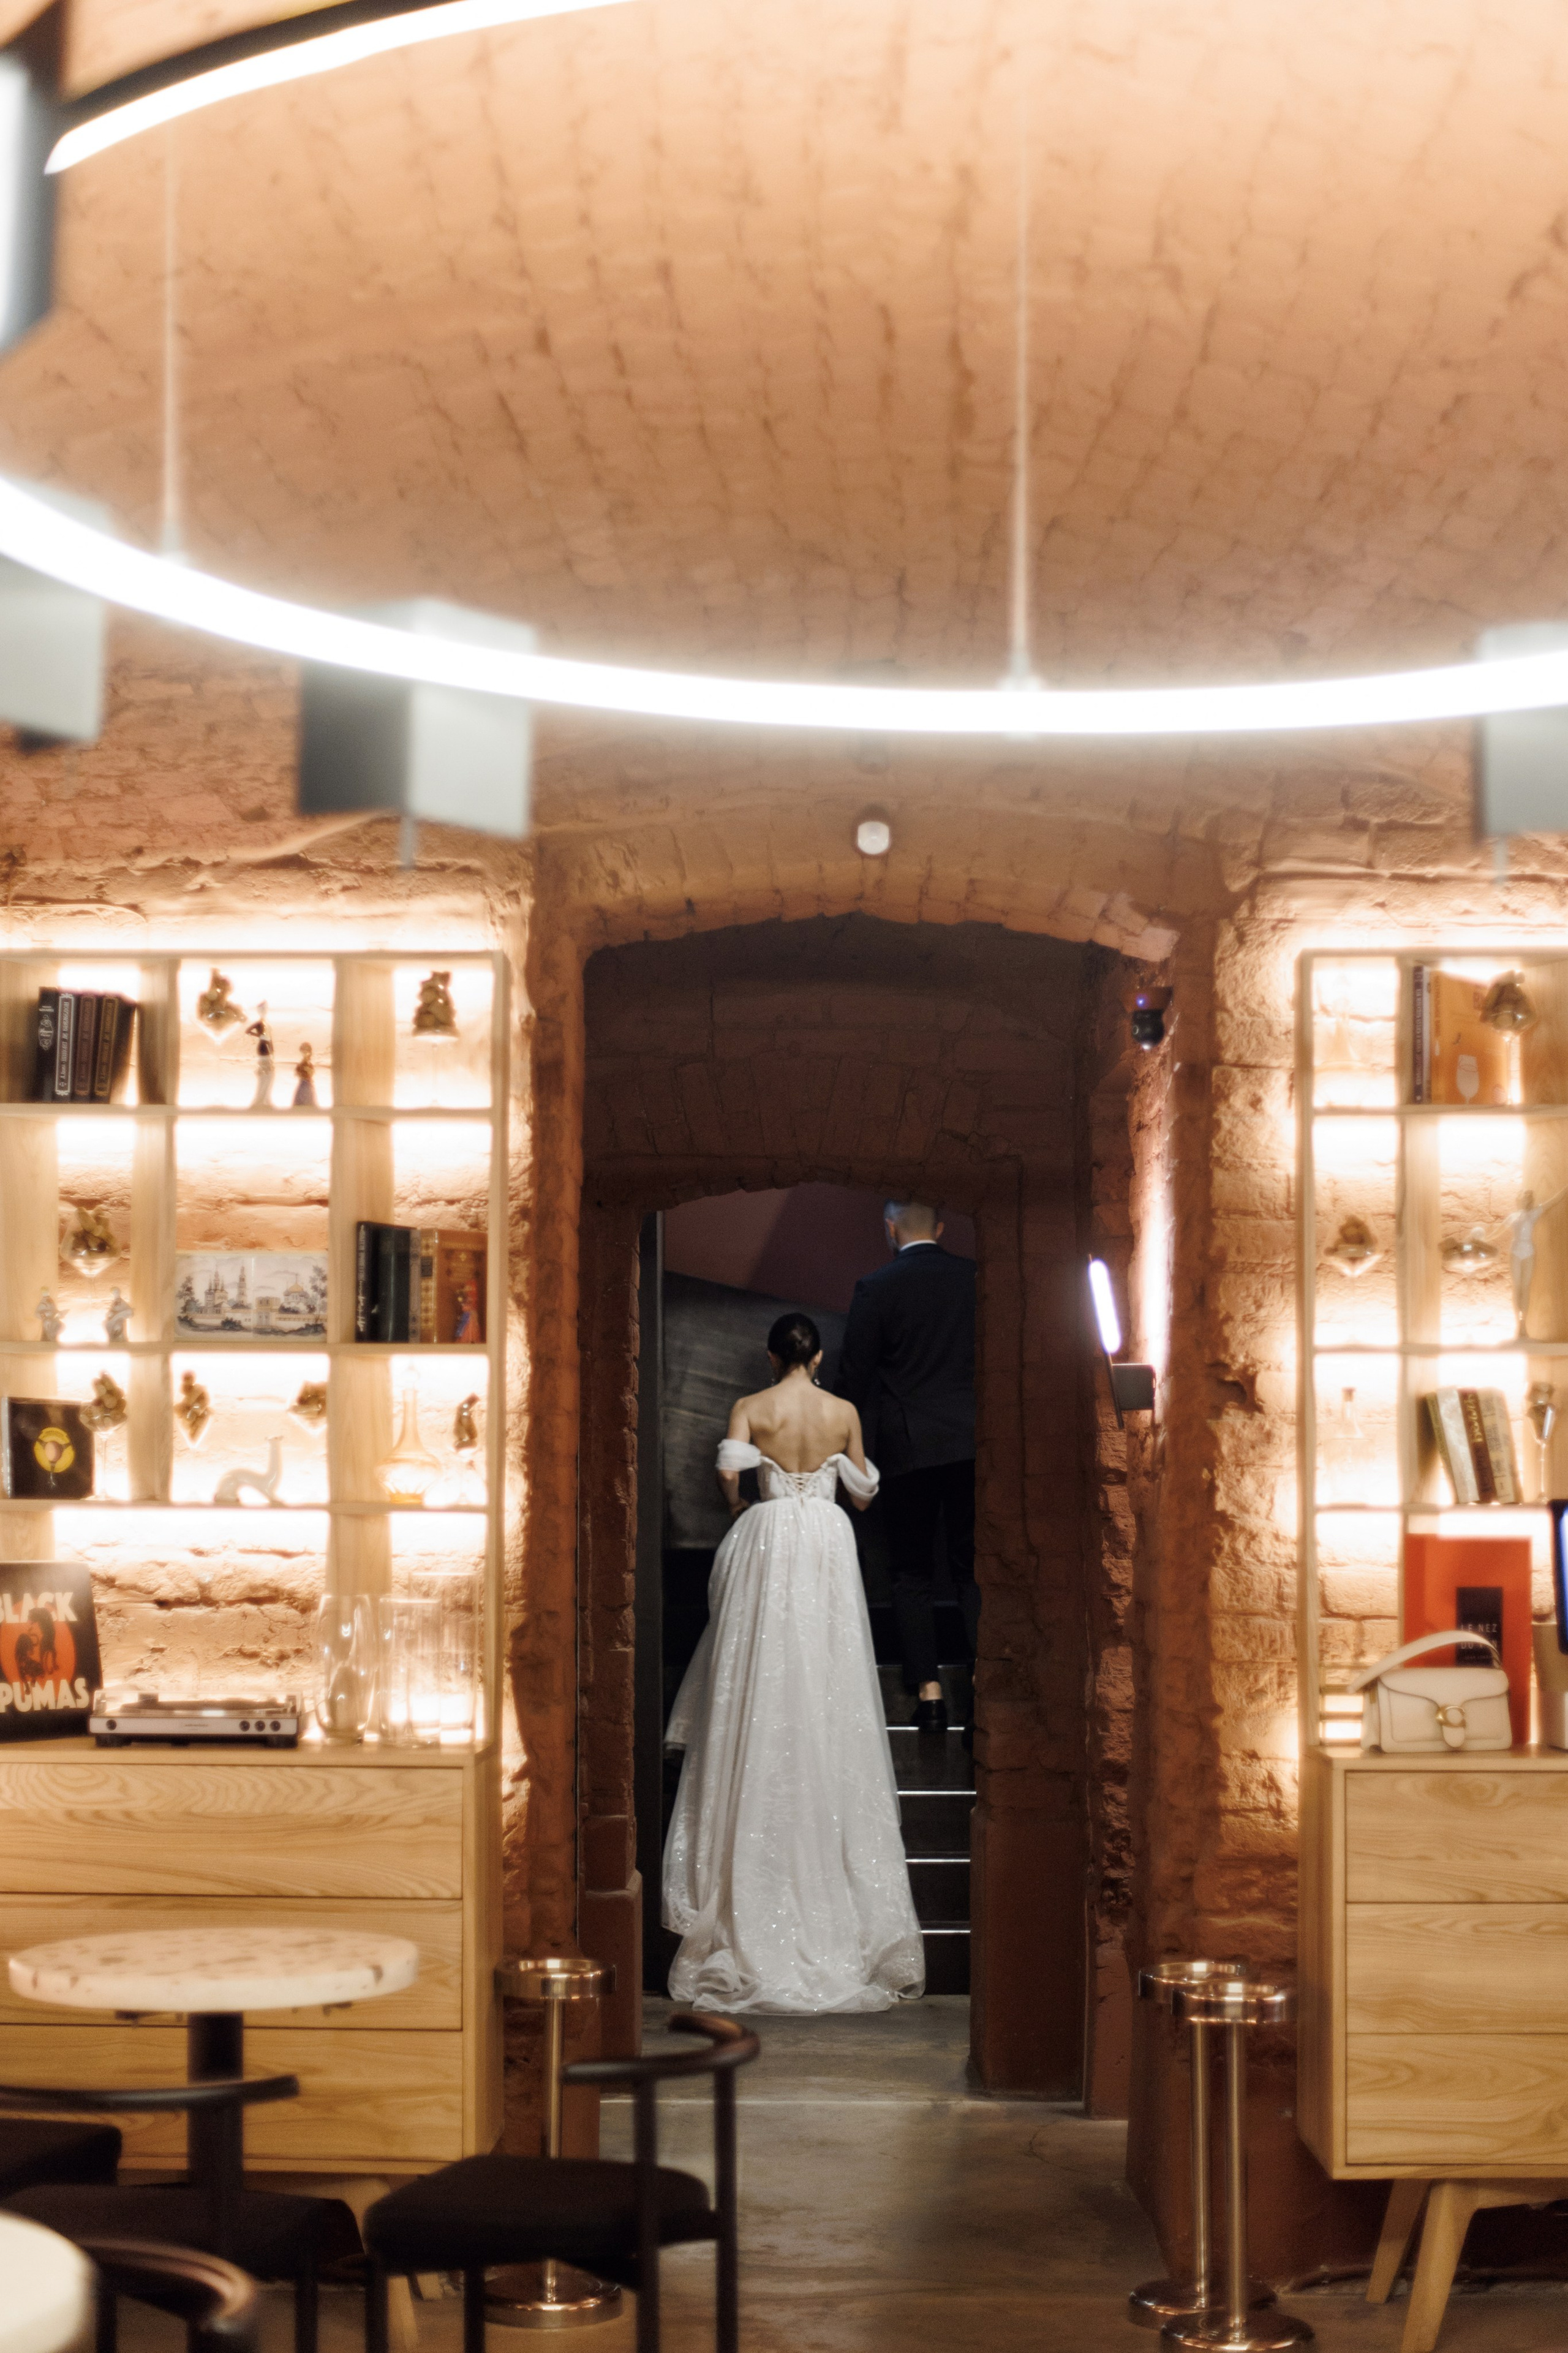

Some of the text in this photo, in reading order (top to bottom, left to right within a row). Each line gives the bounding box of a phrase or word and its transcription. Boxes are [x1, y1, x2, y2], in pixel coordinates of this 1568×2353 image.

[0, 1592, 77, 1623] LACK
[1478, 1623, 1498, 1633] NEZ
[0, 1677, 89, 1713] PUMAS
